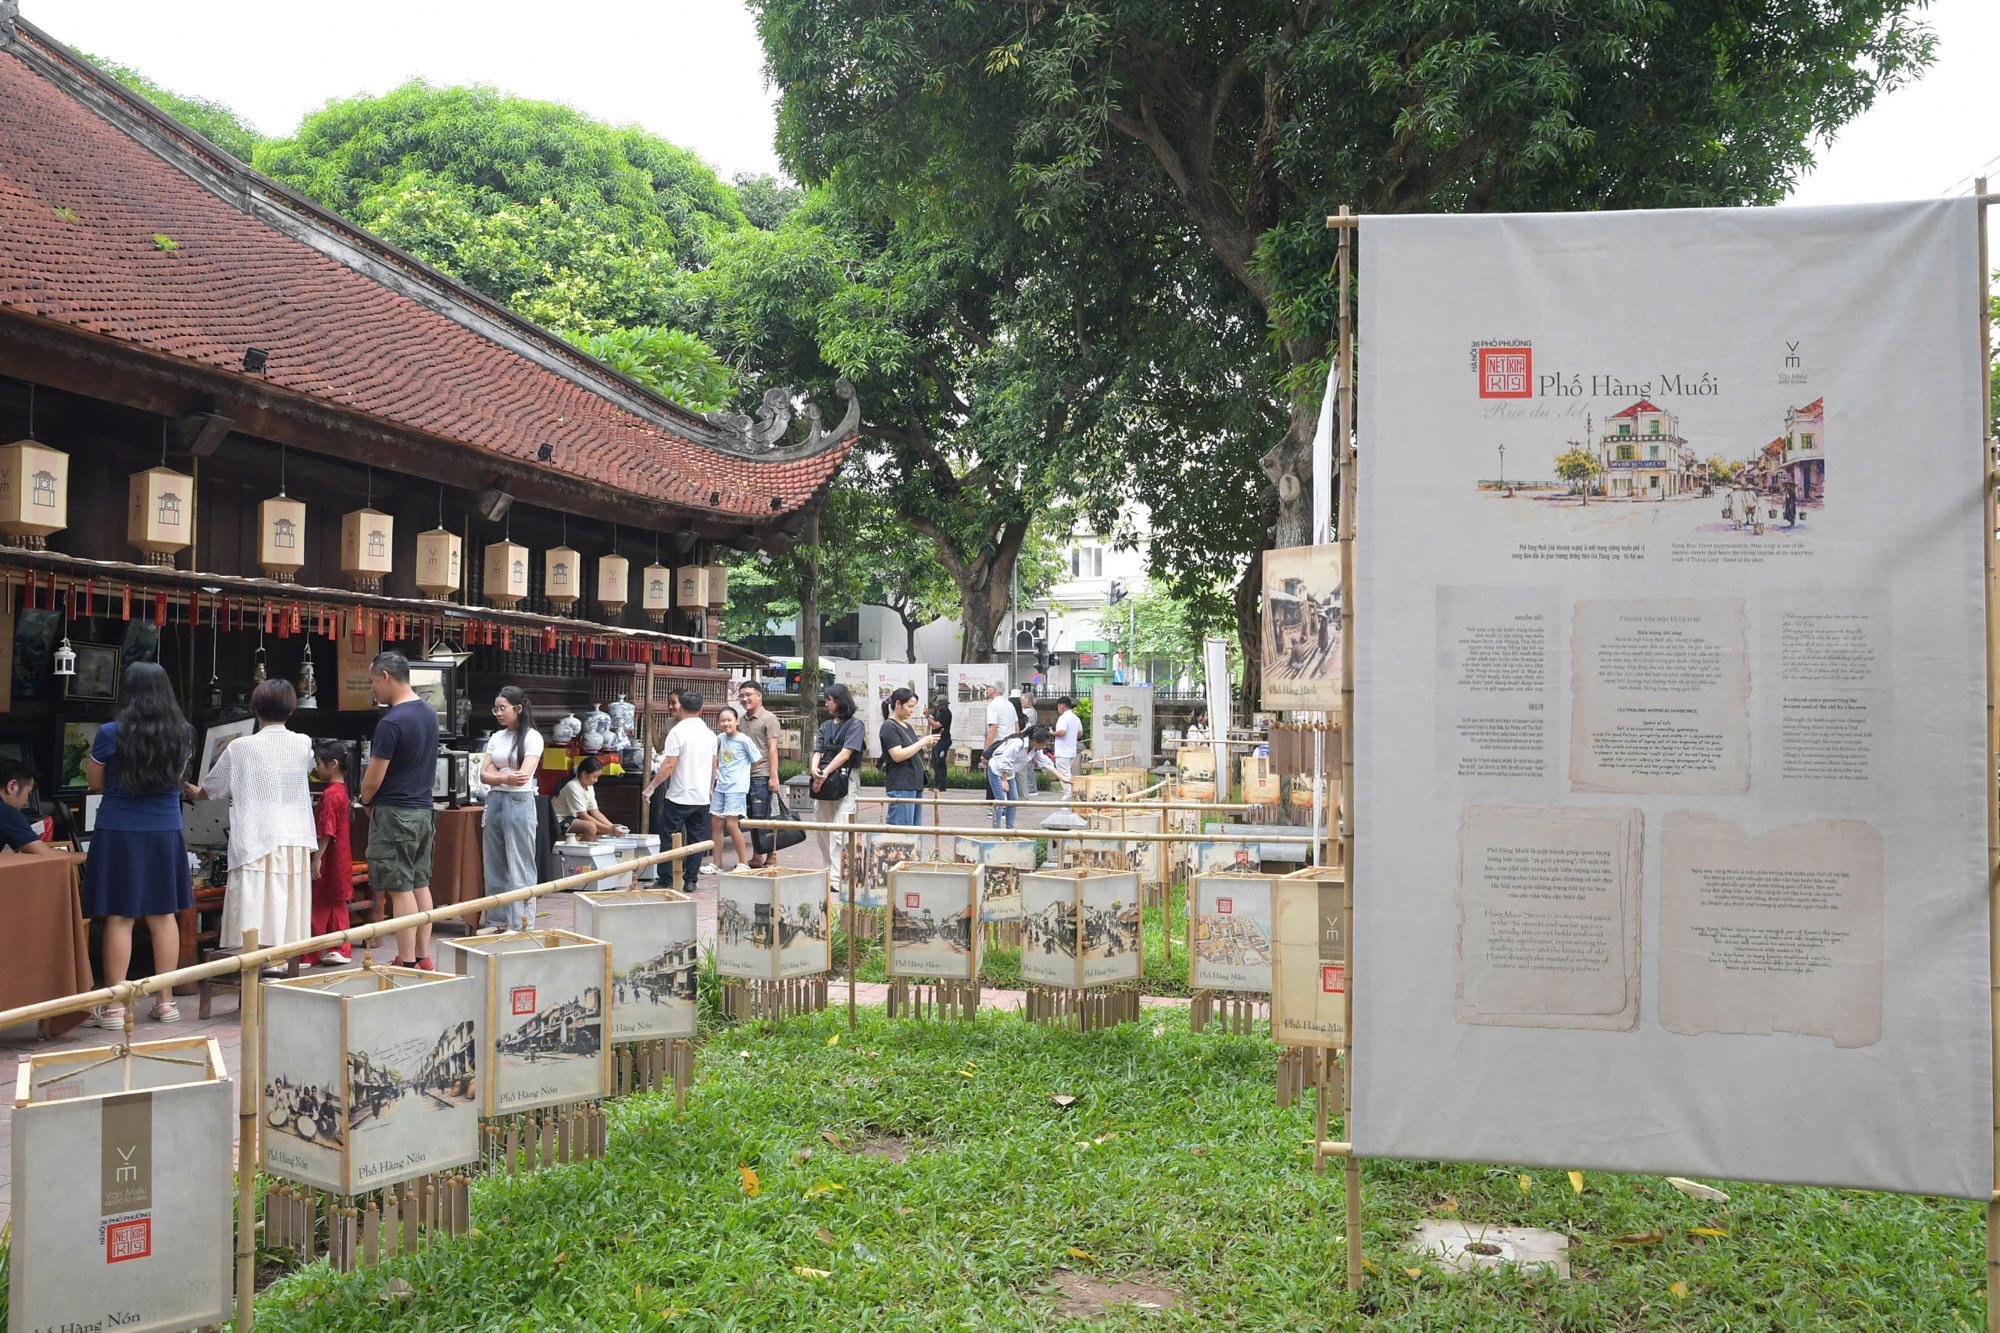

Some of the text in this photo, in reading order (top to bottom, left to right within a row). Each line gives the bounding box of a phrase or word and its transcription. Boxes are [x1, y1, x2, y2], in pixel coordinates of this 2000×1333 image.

[1481, 337, 1497, 347] PHỐ
[1499, 338, 1532, 347] PHƯỜNG
[1539, 372, 1719, 401] Phố Hàng Muối
[1213, 972, 1229, 980] Hàng
[616, 1024, 635, 1032] Hàng
[638, 1022, 653, 1030] Nón
[1284, 1019, 1300, 1029] Phố
[1303, 1020, 1326, 1032] Hàng
[500, 1086, 558, 1103] Phố Hàng Nón
[267, 1148, 308, 1170] Phố Hàng Nón
[358, 1153, 426, 1179] Phố Hàng Nón
[107, 1312, 141, 1327] Nón
